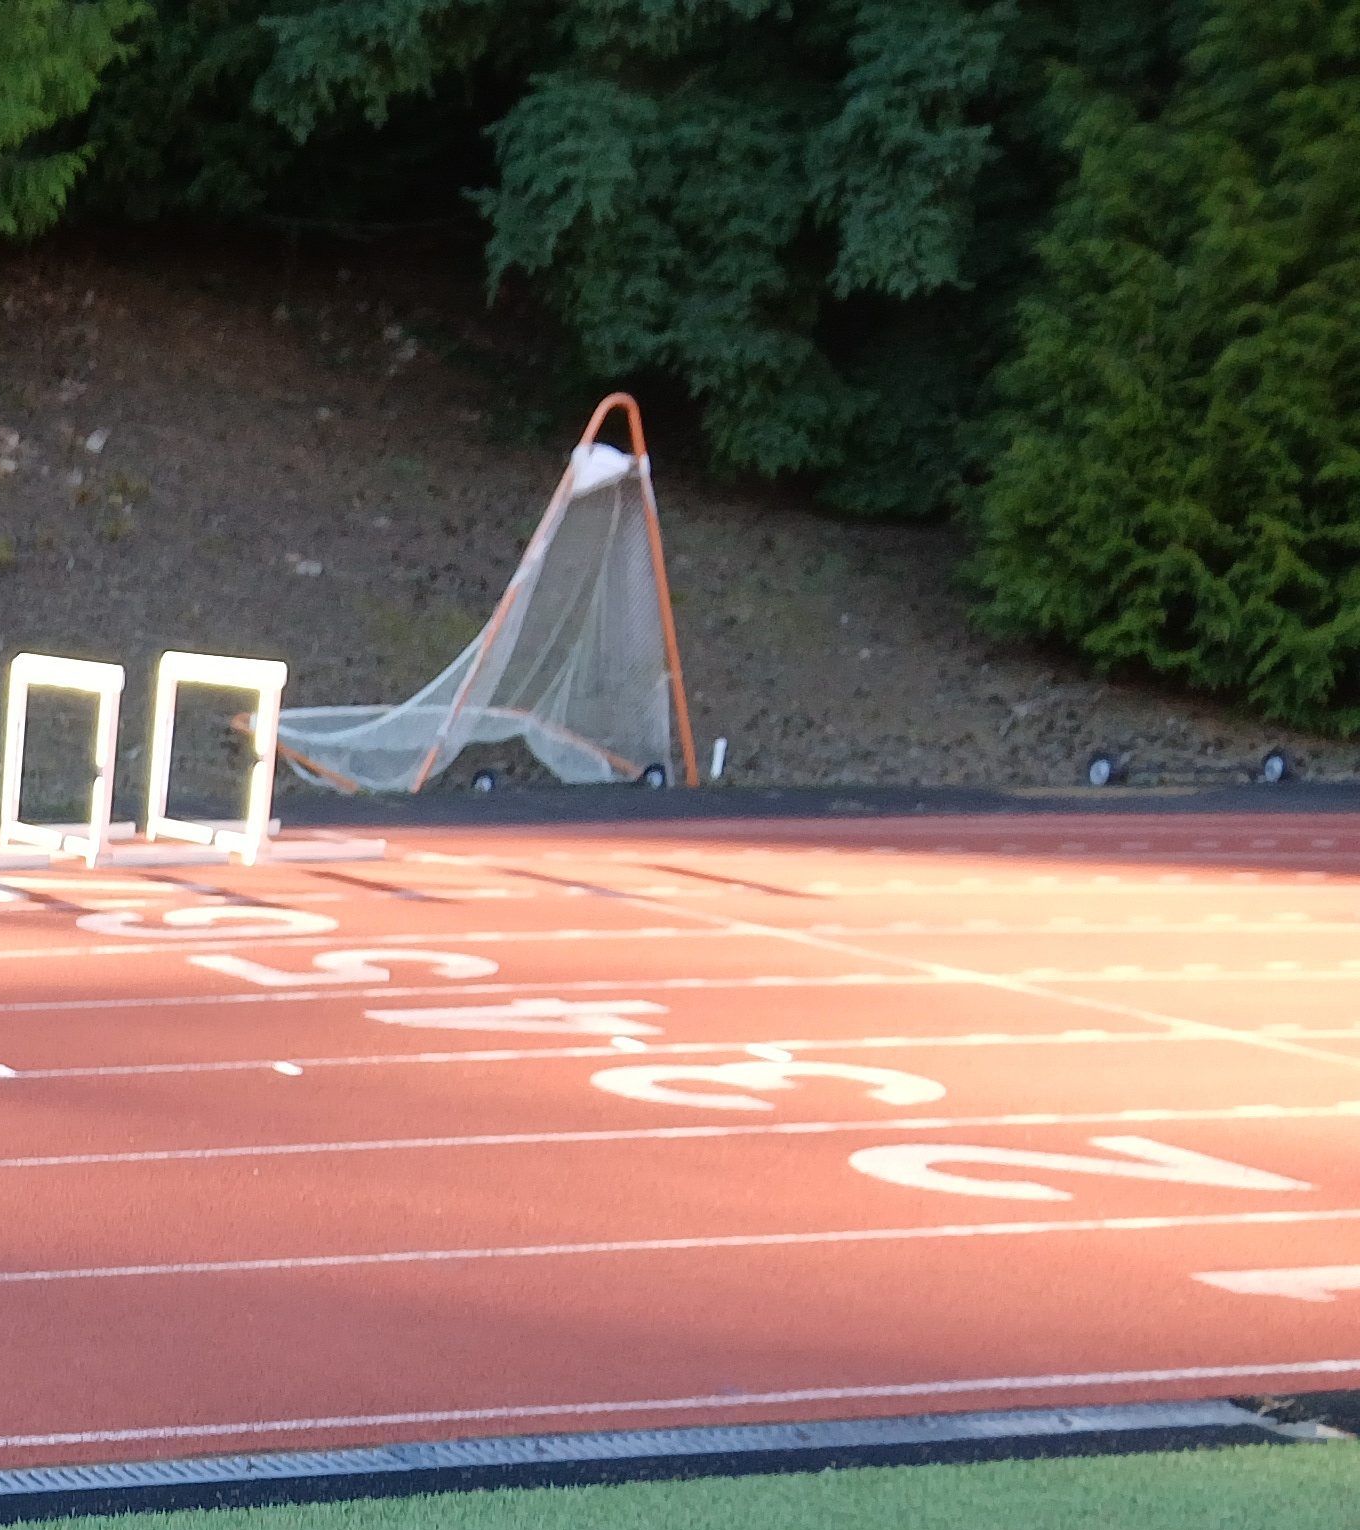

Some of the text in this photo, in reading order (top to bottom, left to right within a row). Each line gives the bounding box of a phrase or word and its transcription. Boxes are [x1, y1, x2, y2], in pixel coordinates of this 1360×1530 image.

[187, 948, 499, 986] 5
[363, 998, 671, 1036] 4
[590, 1061, 946, 1111] 3
[848, 1135, 1317, 1200] 2
